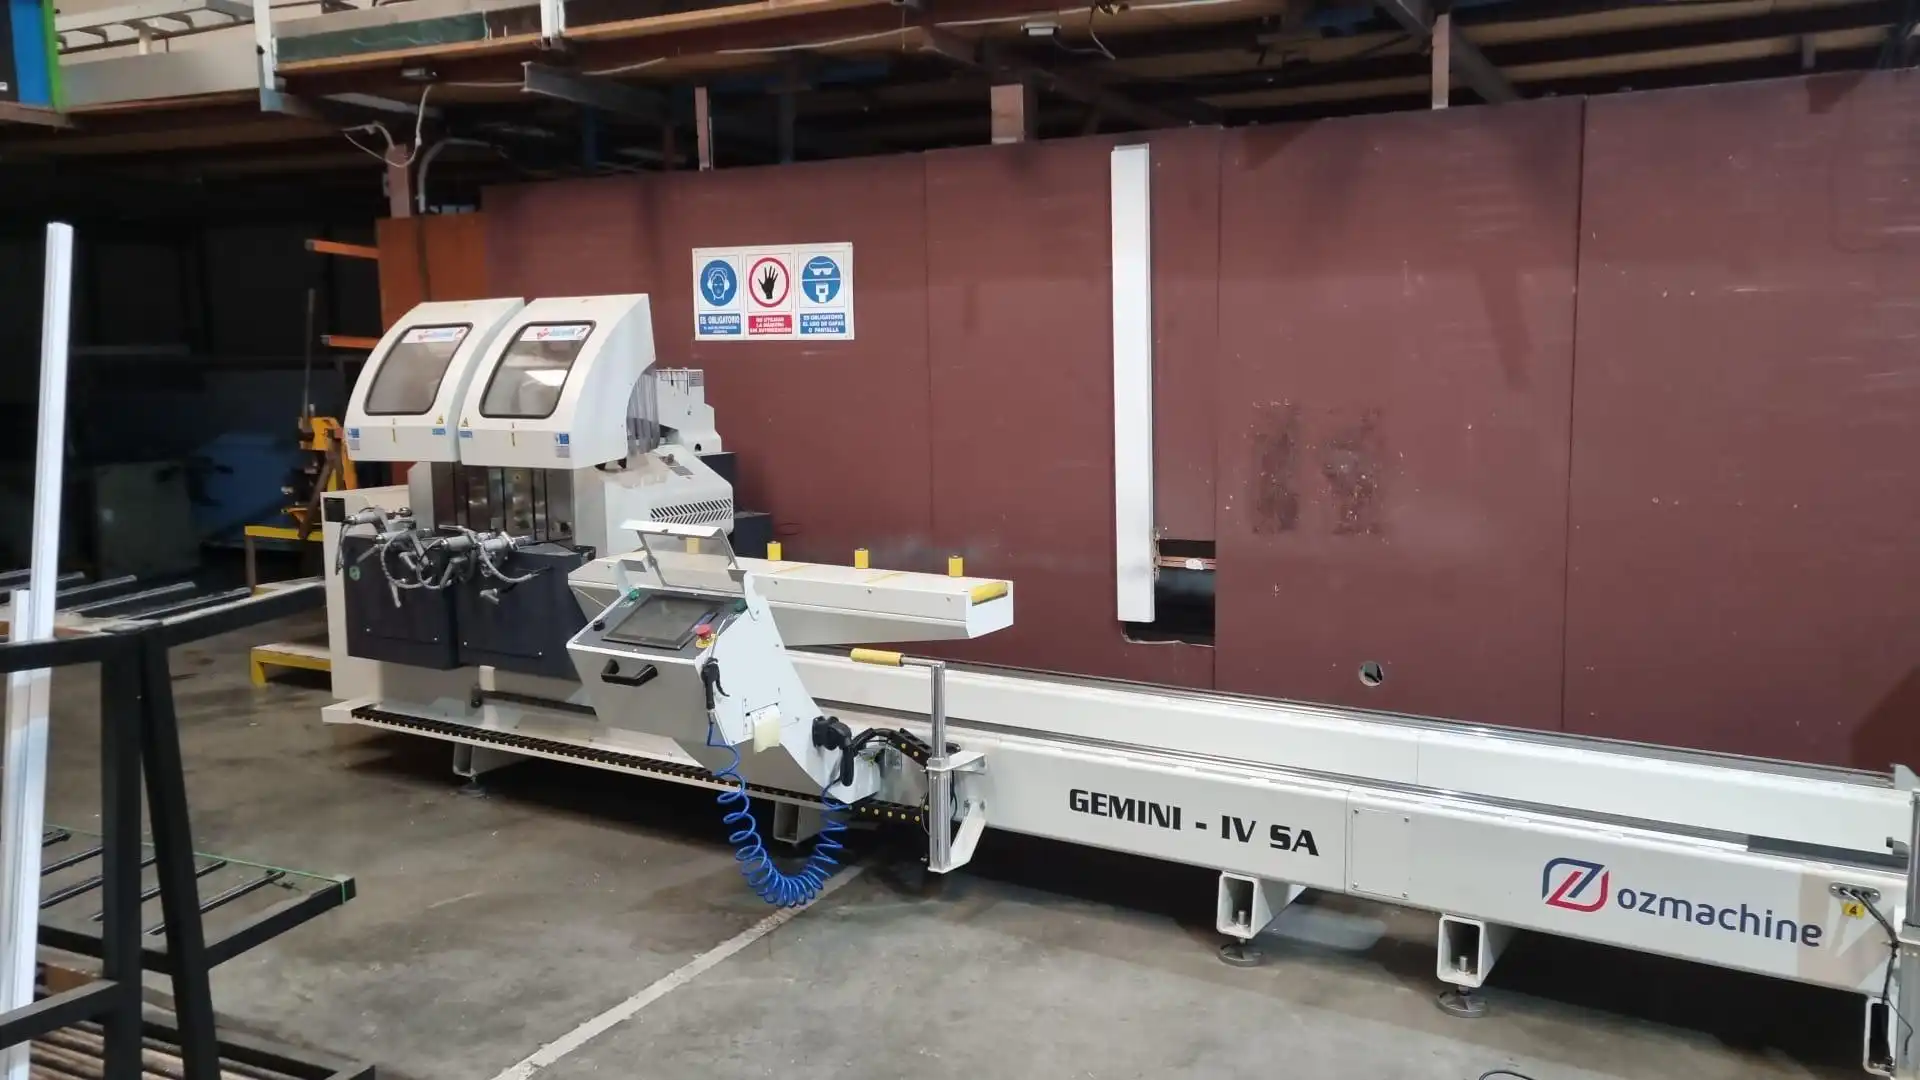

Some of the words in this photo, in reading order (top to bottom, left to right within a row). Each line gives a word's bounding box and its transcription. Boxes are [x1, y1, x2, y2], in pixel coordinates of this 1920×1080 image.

[700, 316, 706, 324] ES
[708, 315, 740, 324] OBLIGATORIO
[1069, 788, 1181, 830] GEMINI
[1221, 815, 1257, 843] IV
[1269, 824, 1319, 857] SA
[1617, 888, 1823, 947] ozmachine
